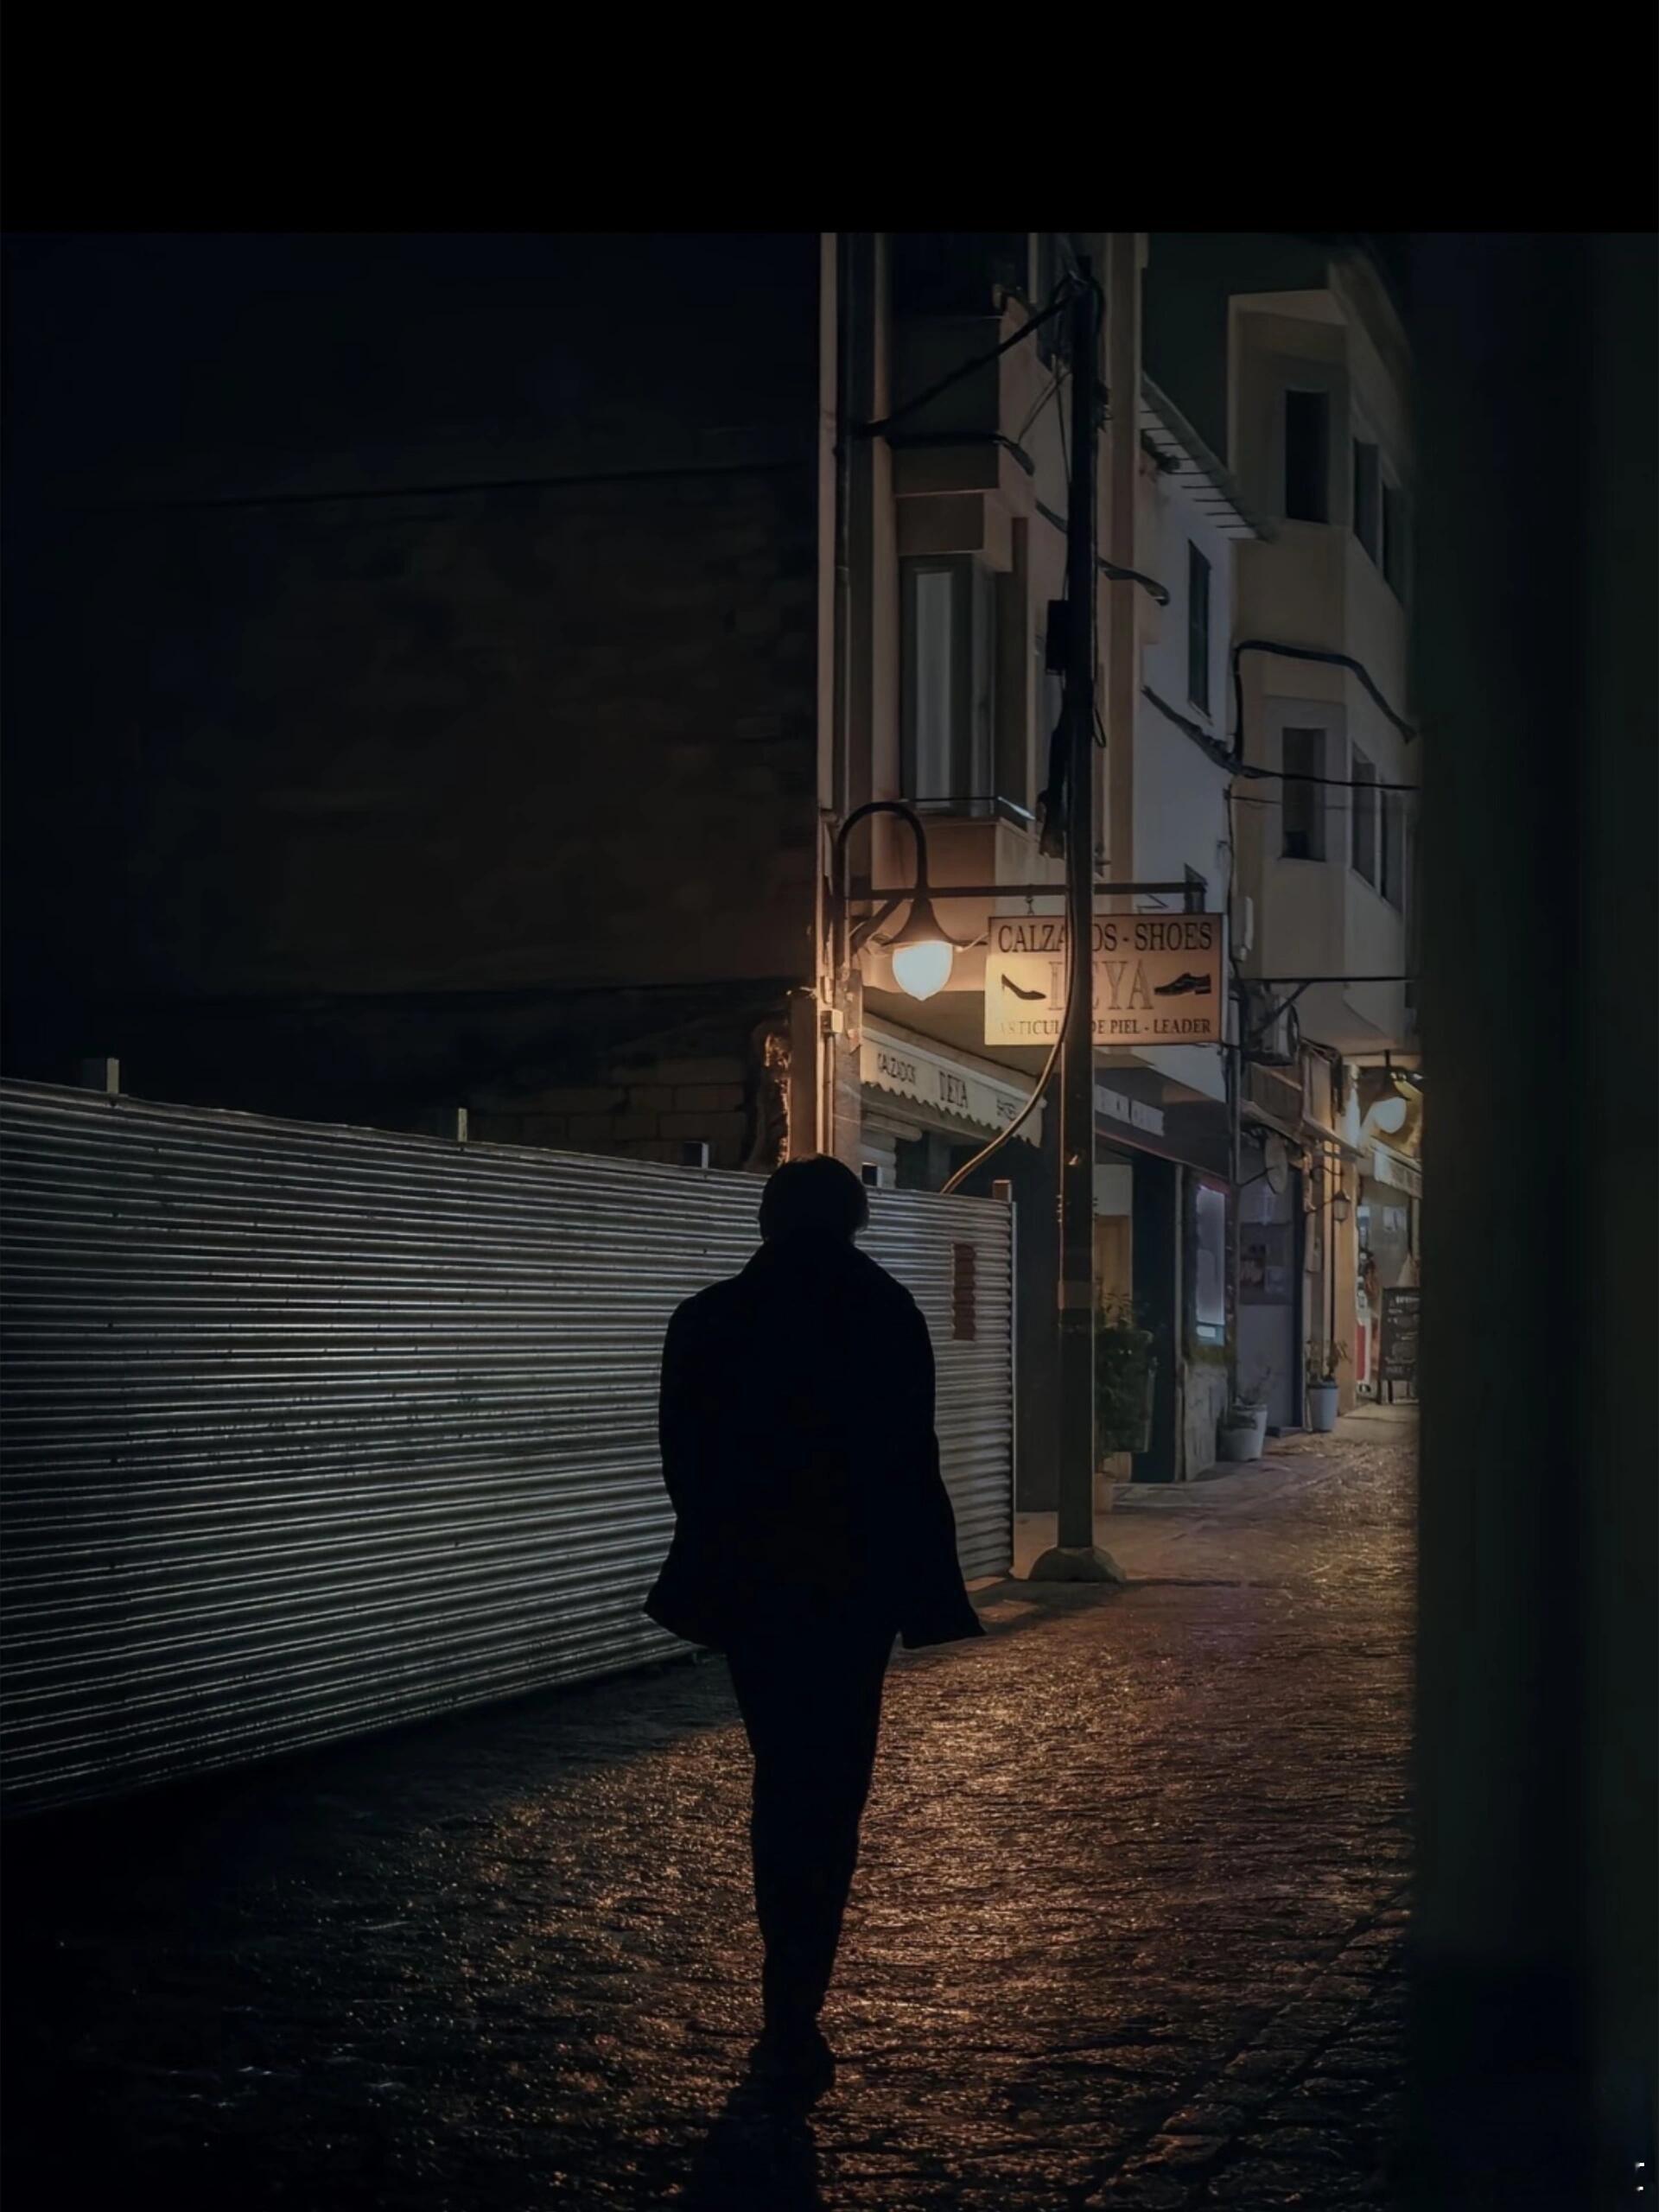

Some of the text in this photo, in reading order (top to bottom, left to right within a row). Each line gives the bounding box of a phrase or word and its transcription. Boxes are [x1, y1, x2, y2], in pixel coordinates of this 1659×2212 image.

[998, 923, 1117, 952] CALZAOS
[1135, 922, 1211, 951] SHOES
[1109, 1020, 1140, 1034] PIEL
